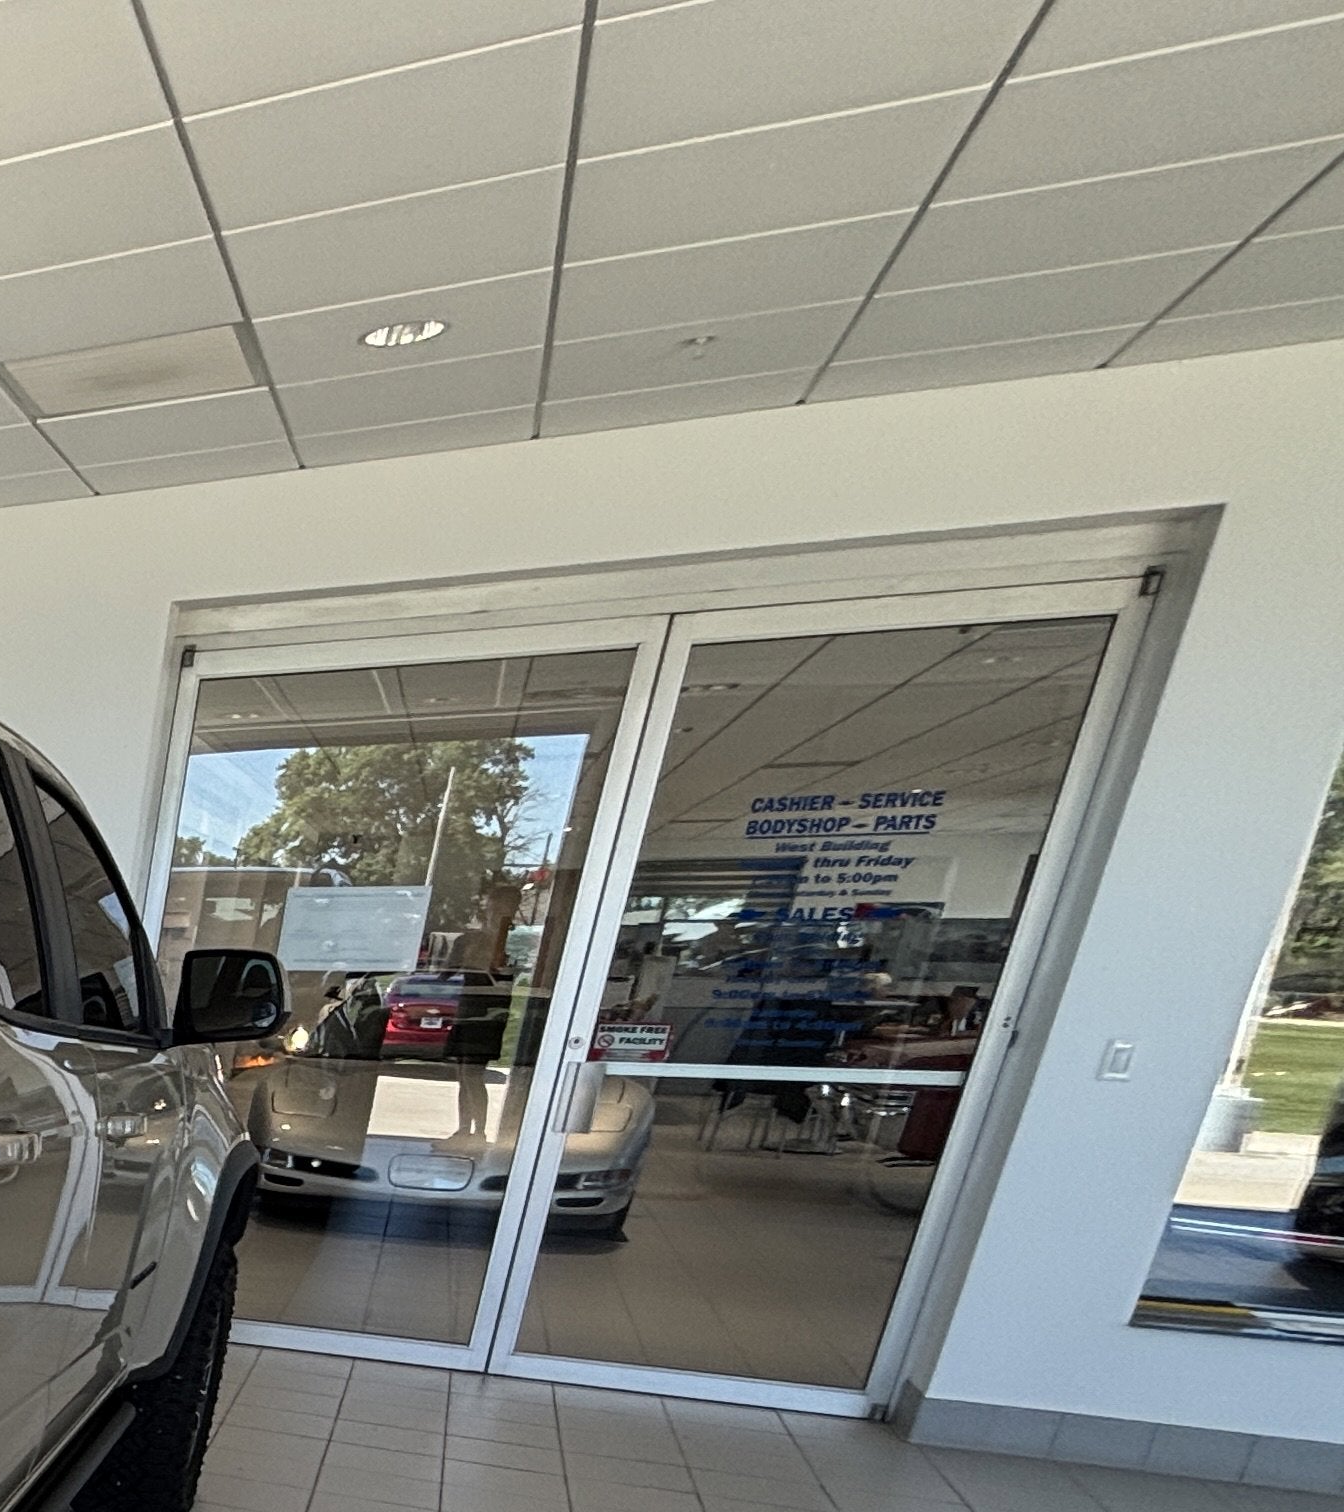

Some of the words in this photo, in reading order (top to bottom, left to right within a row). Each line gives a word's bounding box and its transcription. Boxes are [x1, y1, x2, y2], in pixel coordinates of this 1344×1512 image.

[751, 794, 835, 813] CASHIER
[858, 790, 947, 810] SERVICE
[745, 816, 851, 836] BODYSHOP
[873, 814, 938, 832] PARTS
[775, 841, 816, 853] West
[820, 839, 892, 853] Building
[813, 856, 850, 869] thru
[855, 855, 916, 870] Friday
[815, 873, 832, 884] to
[836, 872, 898, 886] 5:00pm
[775, 906, 855, 922] SALES
[599, 1025, 638, 1034] SMOKE
[639, 1026, 668, 1035] FREE
[618, 1037, 665, 1046] FACILITY
